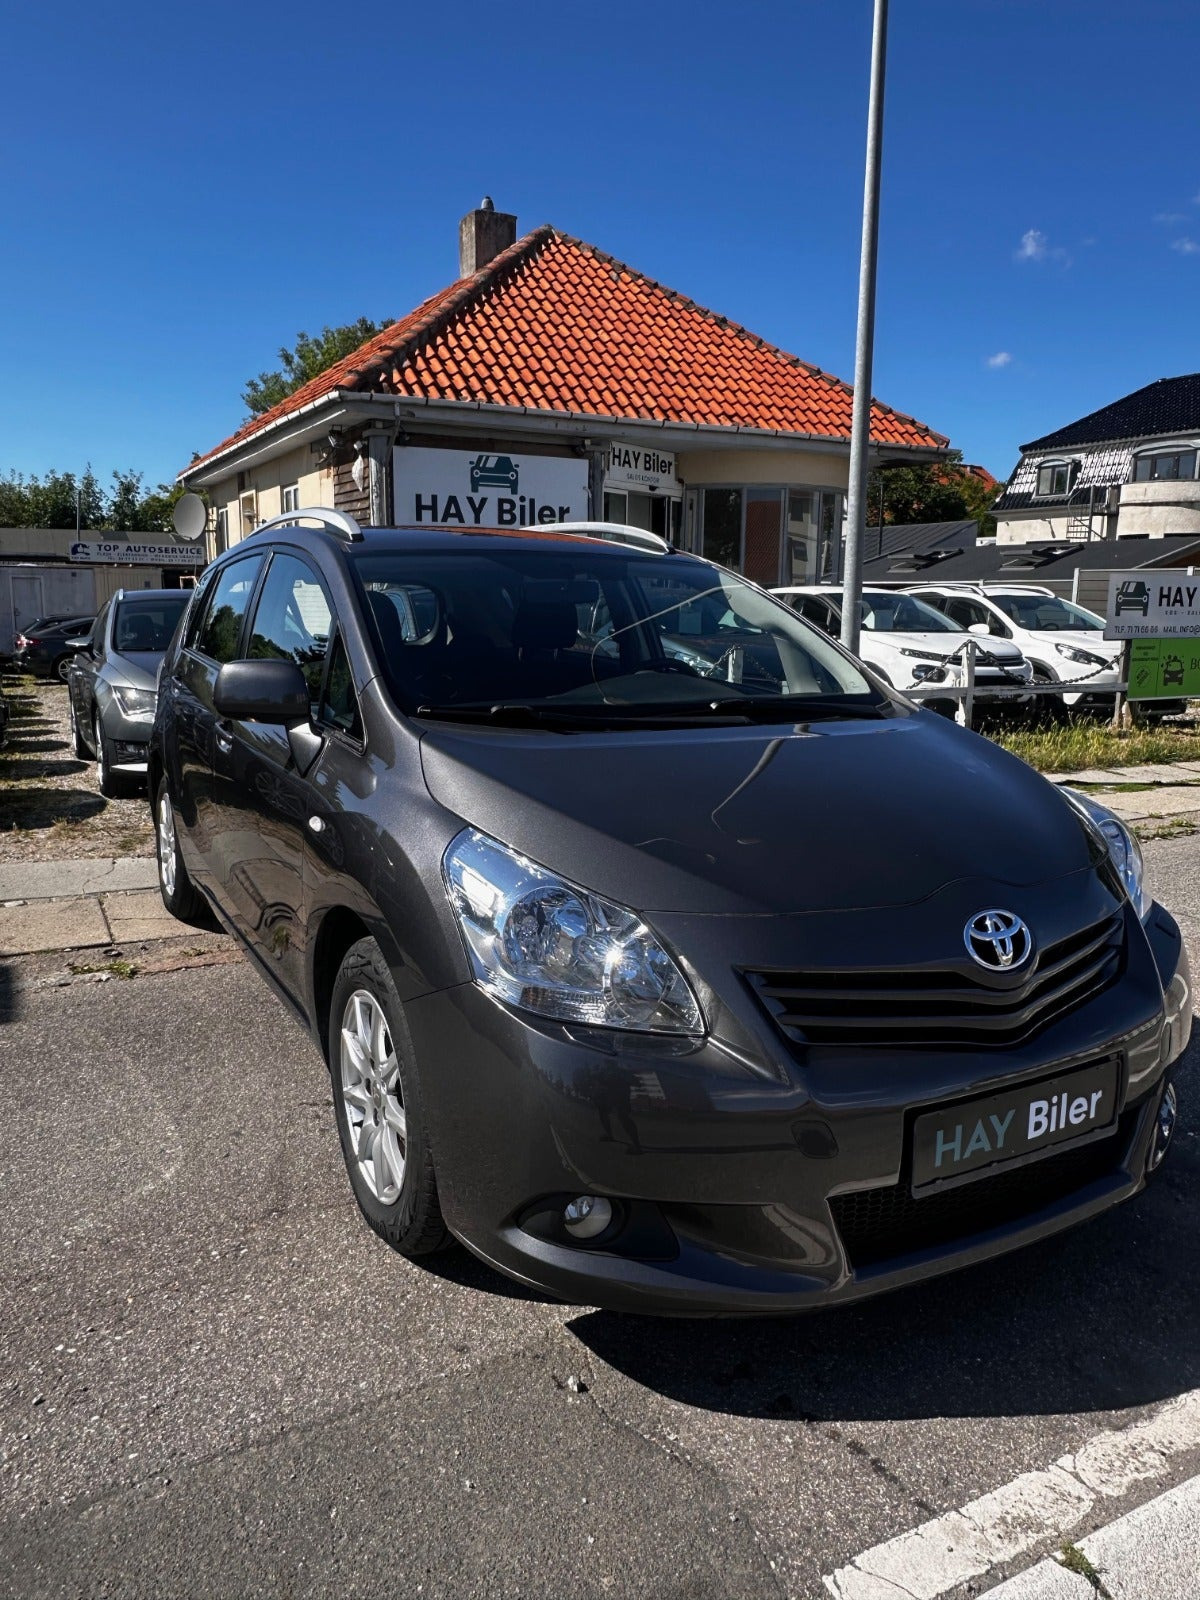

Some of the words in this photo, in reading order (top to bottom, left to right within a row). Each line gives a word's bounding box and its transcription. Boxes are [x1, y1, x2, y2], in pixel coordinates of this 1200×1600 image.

[612, 446, 641, 469] HAY
[644, 452, 673, 475] Biler
[415, 493, 489, 525] HAY
[497, 495, 571, 526] Biler
[97, 543, 120, 552] TOP
[125, 545, 203, 555] AUTOSERVICE
[1158, 586, 1198, 608] HAY
[935, 1109, 1016, 1168] HAY
[1027, 1089, 1103, 1140] Biler
